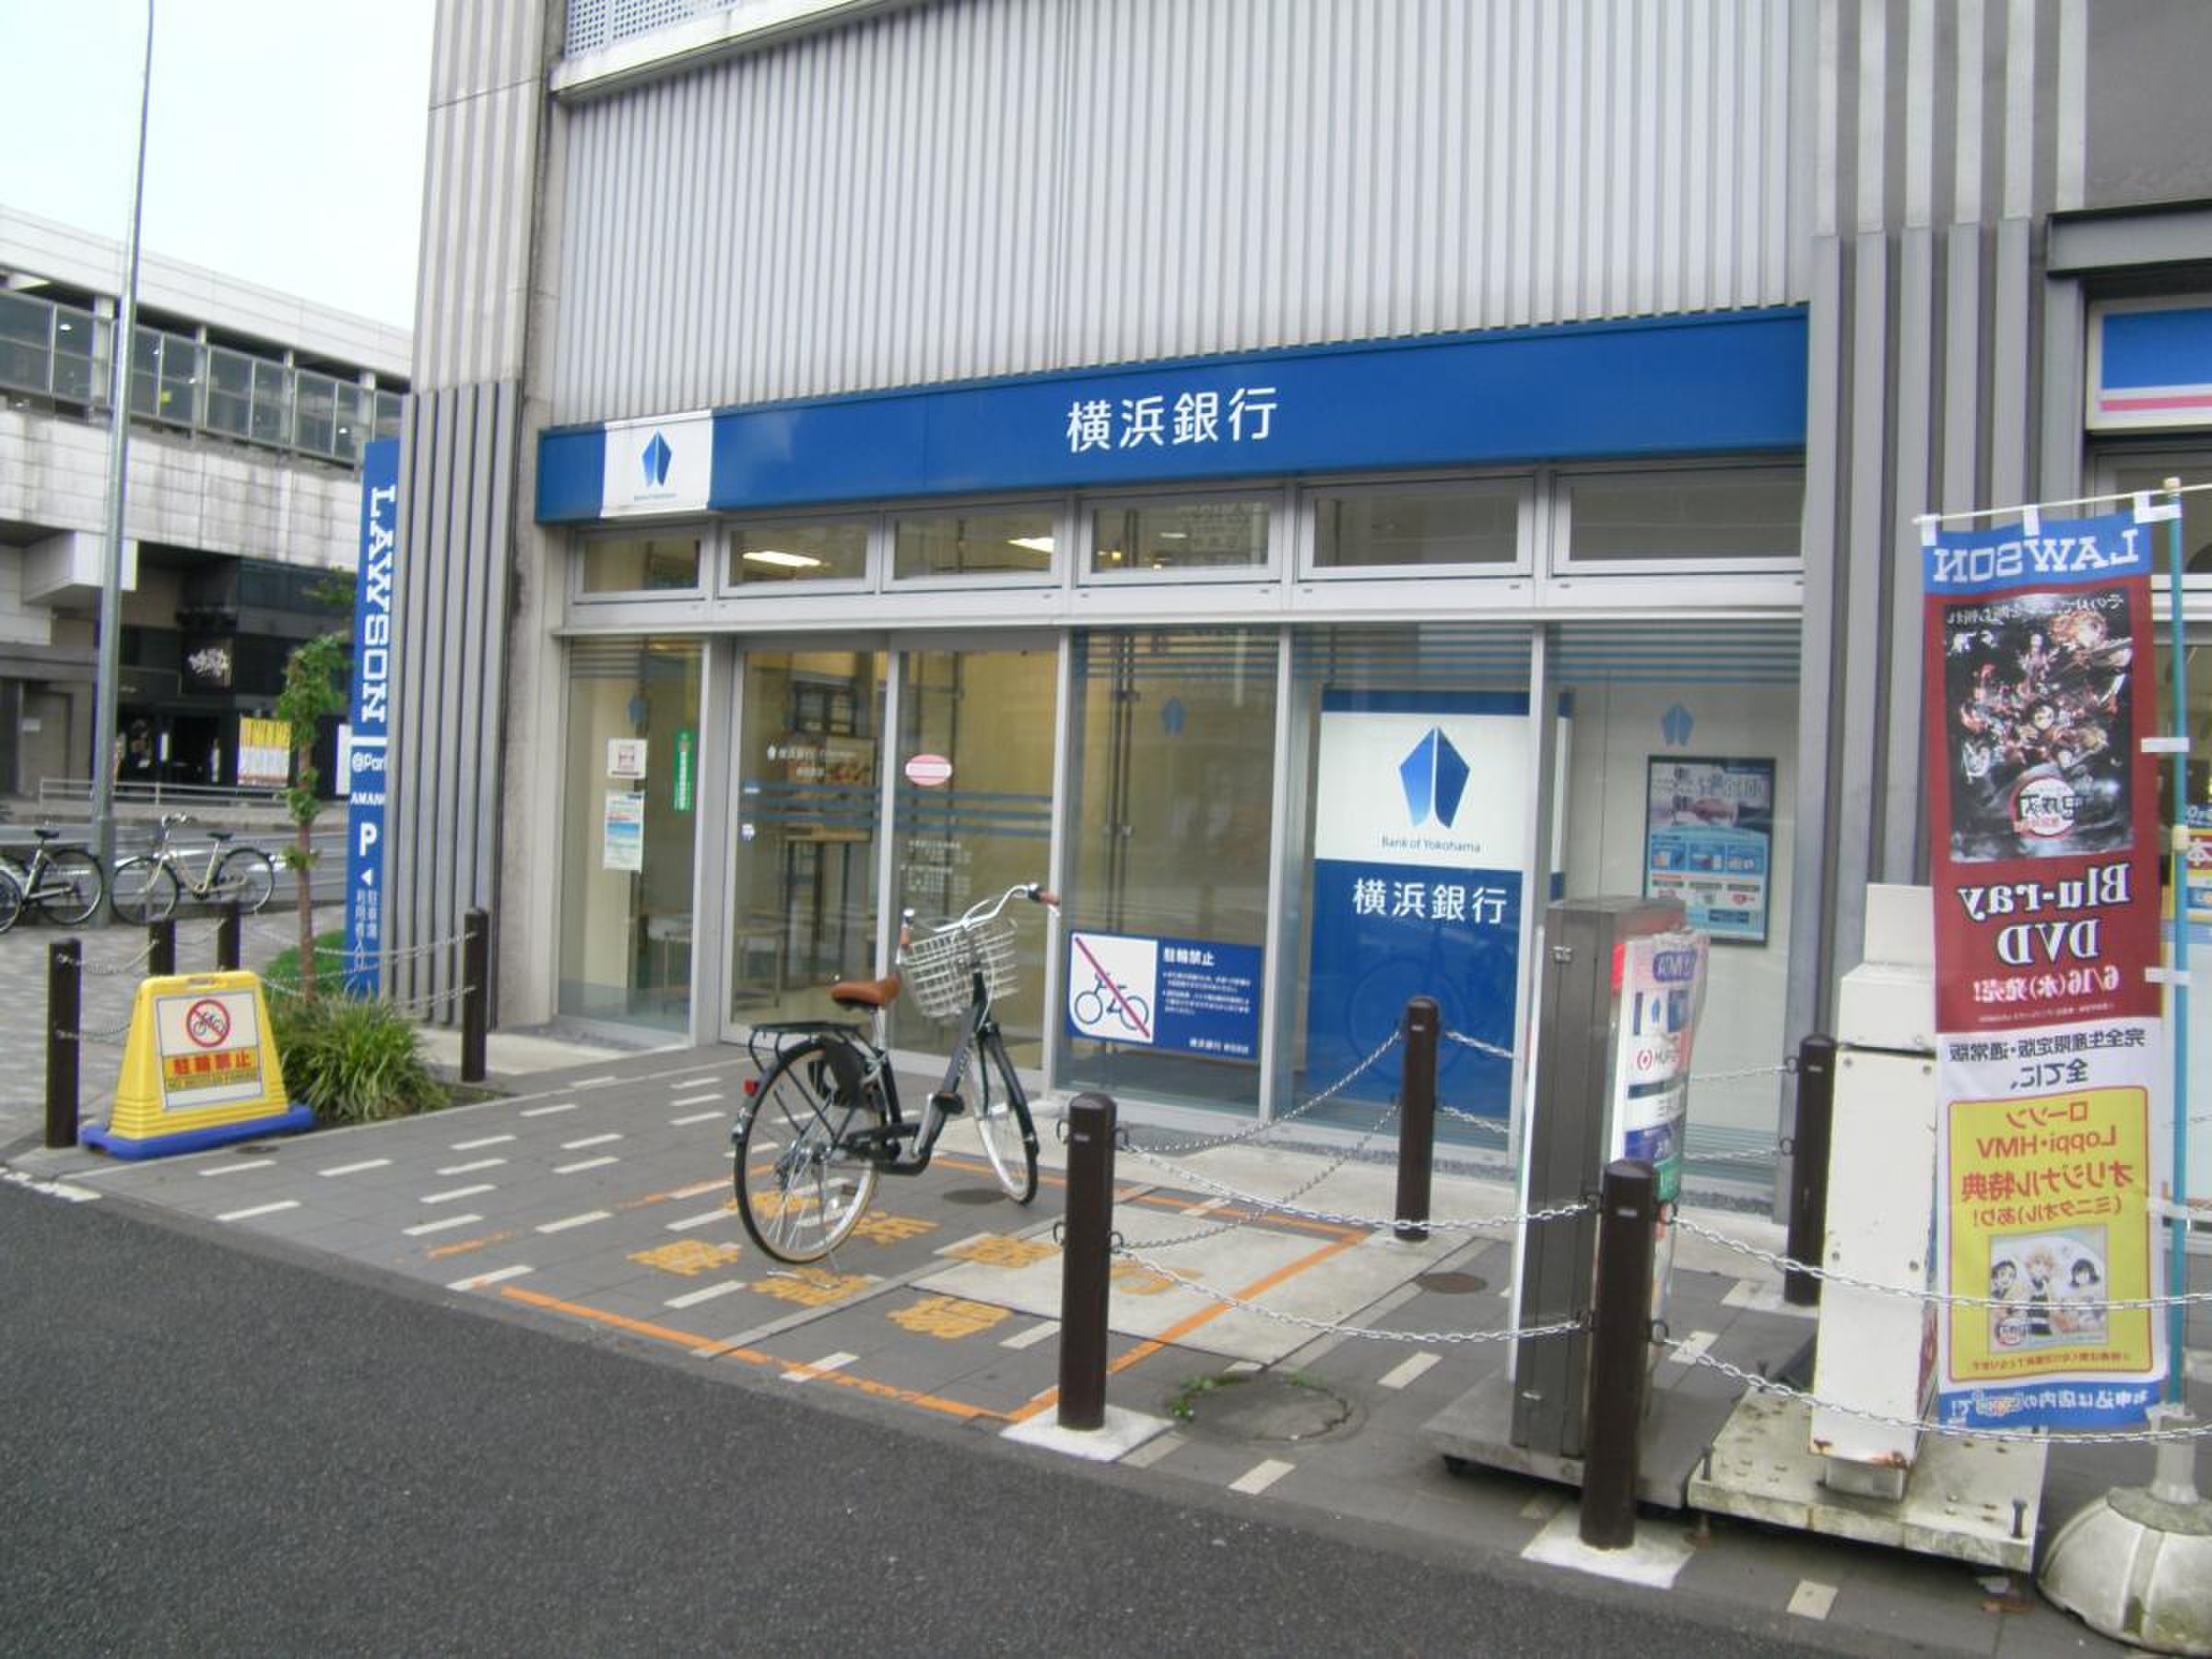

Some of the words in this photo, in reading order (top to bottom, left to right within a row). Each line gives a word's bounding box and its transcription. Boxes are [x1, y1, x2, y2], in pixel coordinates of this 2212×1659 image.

[1066, 386, 1277, 453] 横浜銀行
[361, 485, 396, 724] LAWSON
[359, 821, 378, 856] P
[1382, 835, 1407, 849] Bank
[1410, 838, 1421, 850] of
[1424, 839, 1481, 853] Yokohama
[1352, 877, 1507, 925] 横浜銀行
